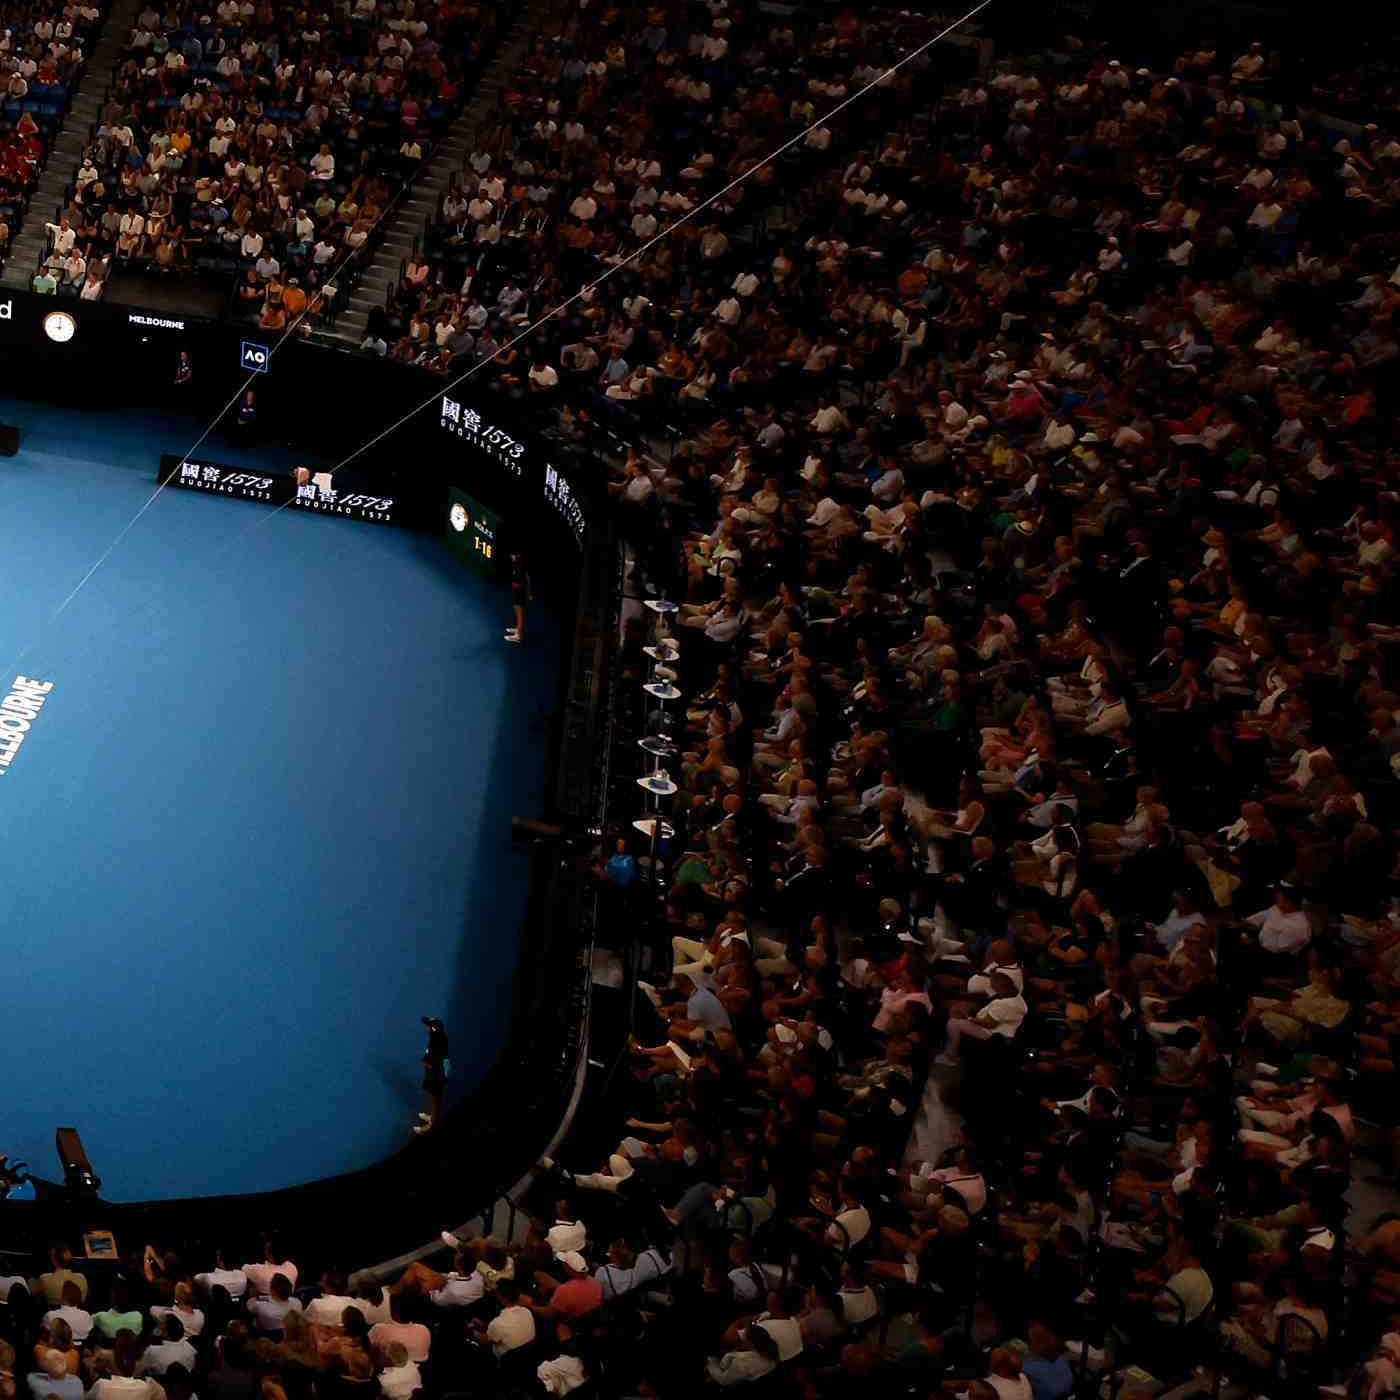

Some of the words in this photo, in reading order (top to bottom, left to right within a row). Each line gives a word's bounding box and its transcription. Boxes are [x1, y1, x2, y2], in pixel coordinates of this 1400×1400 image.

[128, 315, 185, 330] MELBOURNE
[245, 350, 265, 363] AO
[441, 418, 492, 453] GUOJIAO
[499, 453, 522, 475] 1573
[180, 478, 233, 493] GUOJIAO
[242, 489, 271, 499] 1573
[295, 498, 352, 514] GUOJIAO
[361, 510, 391, 521] 1573
